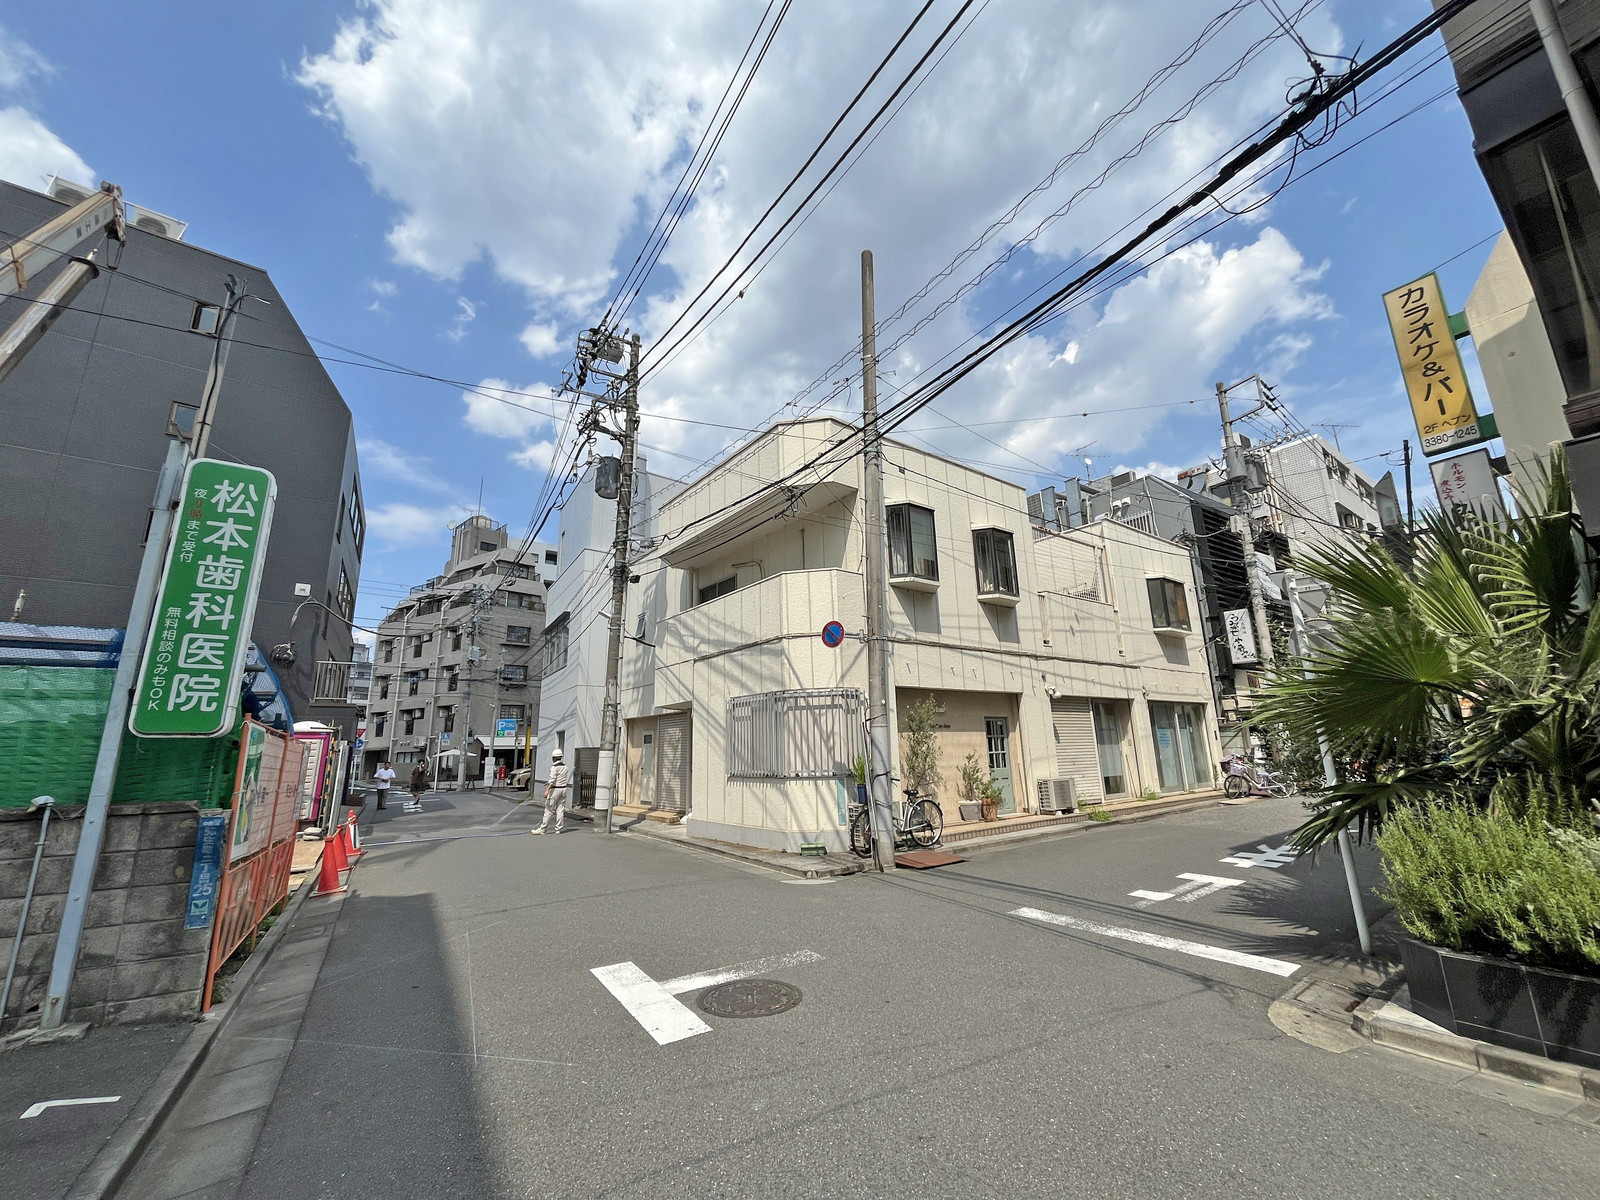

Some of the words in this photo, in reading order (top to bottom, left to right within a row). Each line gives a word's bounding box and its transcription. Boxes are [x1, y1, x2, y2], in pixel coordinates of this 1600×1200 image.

[1398, 286, 1454, 416] カラオケ&バー
[1423, 421, 1439, 435] 2F
[1442, 414, 1471, 428] ヘブン
[1424, 425, 1478, 448] 3380-1245
[167, 479, 259, 712] 松本歯科医院
[147, 606, 182, 711] 無料相談のみもOK
